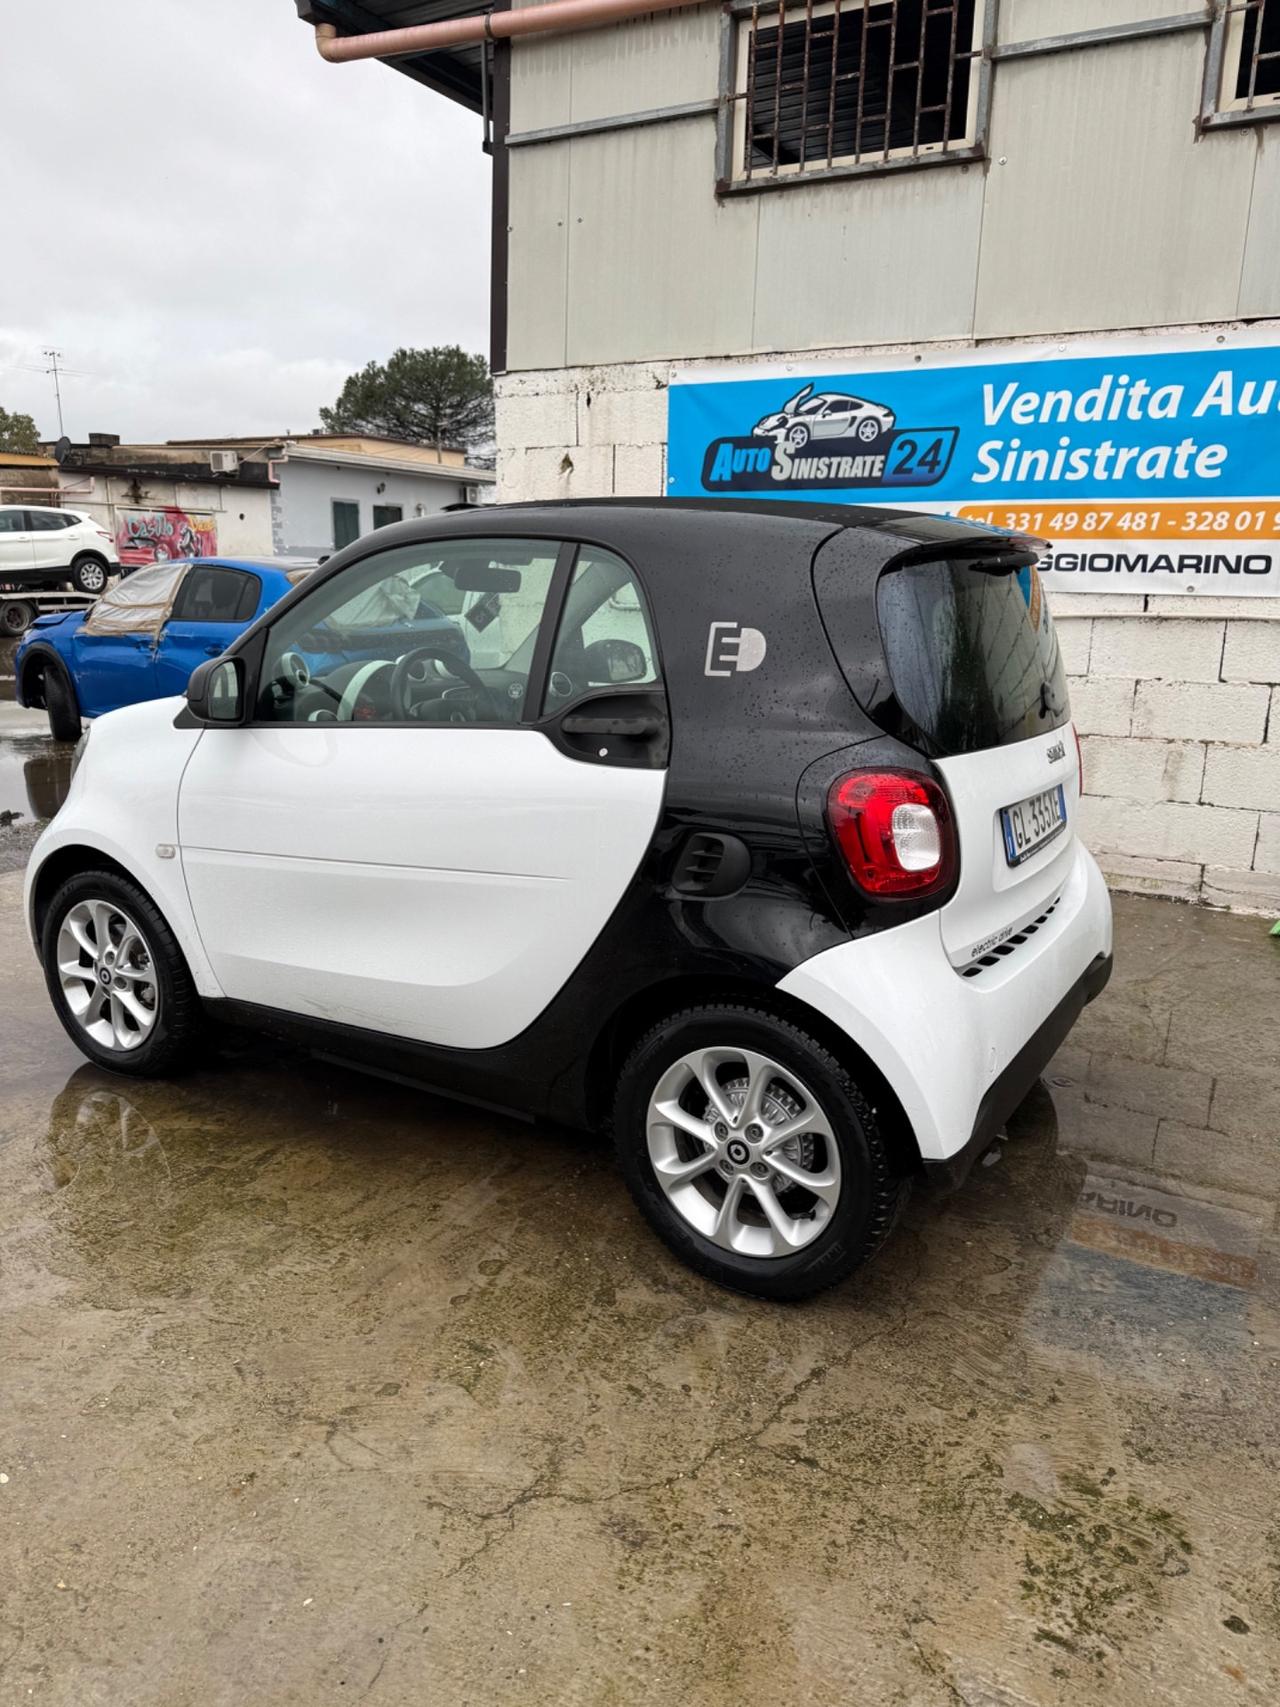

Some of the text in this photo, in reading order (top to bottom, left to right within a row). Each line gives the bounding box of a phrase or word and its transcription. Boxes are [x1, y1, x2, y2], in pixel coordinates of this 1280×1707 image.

[983, 370, 1280, 426] Vendita Au
[892, 438, 944, 476] 24
[971, 436, 1228, 483] Sinistrate
[1005, 512, 1044, 531] 331
[1049, 511, 1079, 532] 49
[1082, 511, 1114, 531] 87
[1116, 511, 1161, 532] 481
[1181, 510, 1230, 532] 328
[1234, 510, 1266, 532] 01
